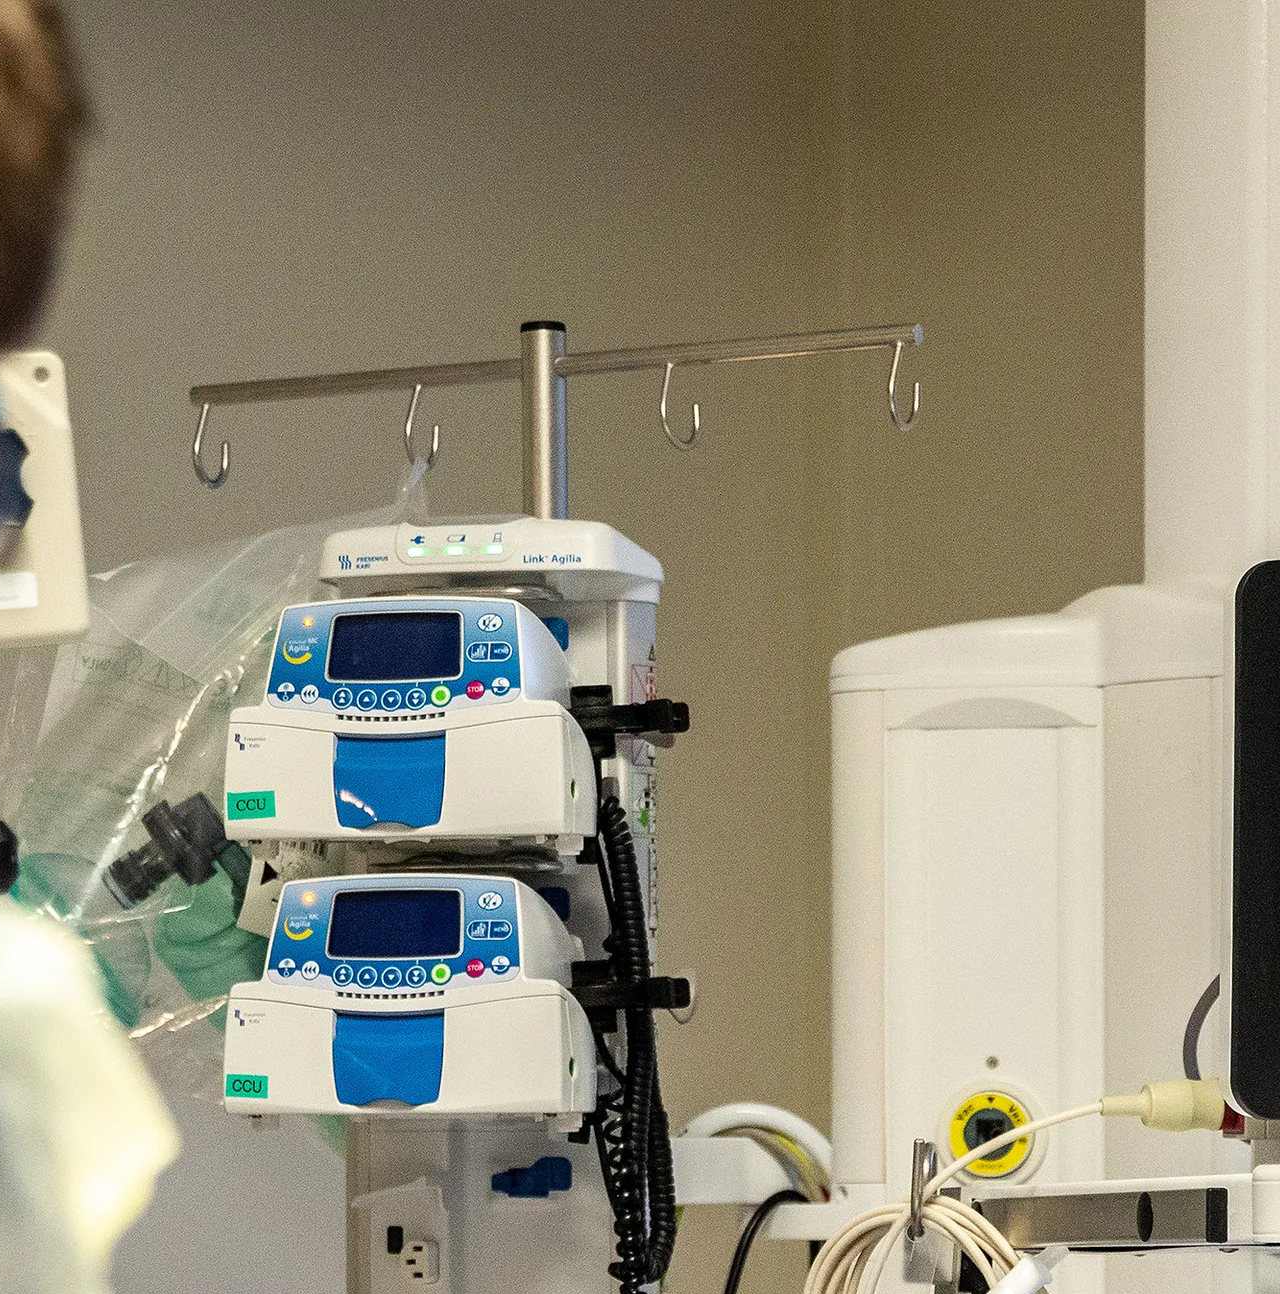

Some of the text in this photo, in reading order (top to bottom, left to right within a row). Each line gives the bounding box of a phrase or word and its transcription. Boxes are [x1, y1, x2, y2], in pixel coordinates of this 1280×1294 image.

[356, 555, 389, 563] FRESENIUS
[551, 554, 582, 566] Agilia
[288, 645, 310, 653] Agilia
[236, 797, 267, 812] CCU
[289, 921, 311, 929] Agilia
[467, 964, 484, 972] STOP
[232, 1079, 263, 1094] CCU
